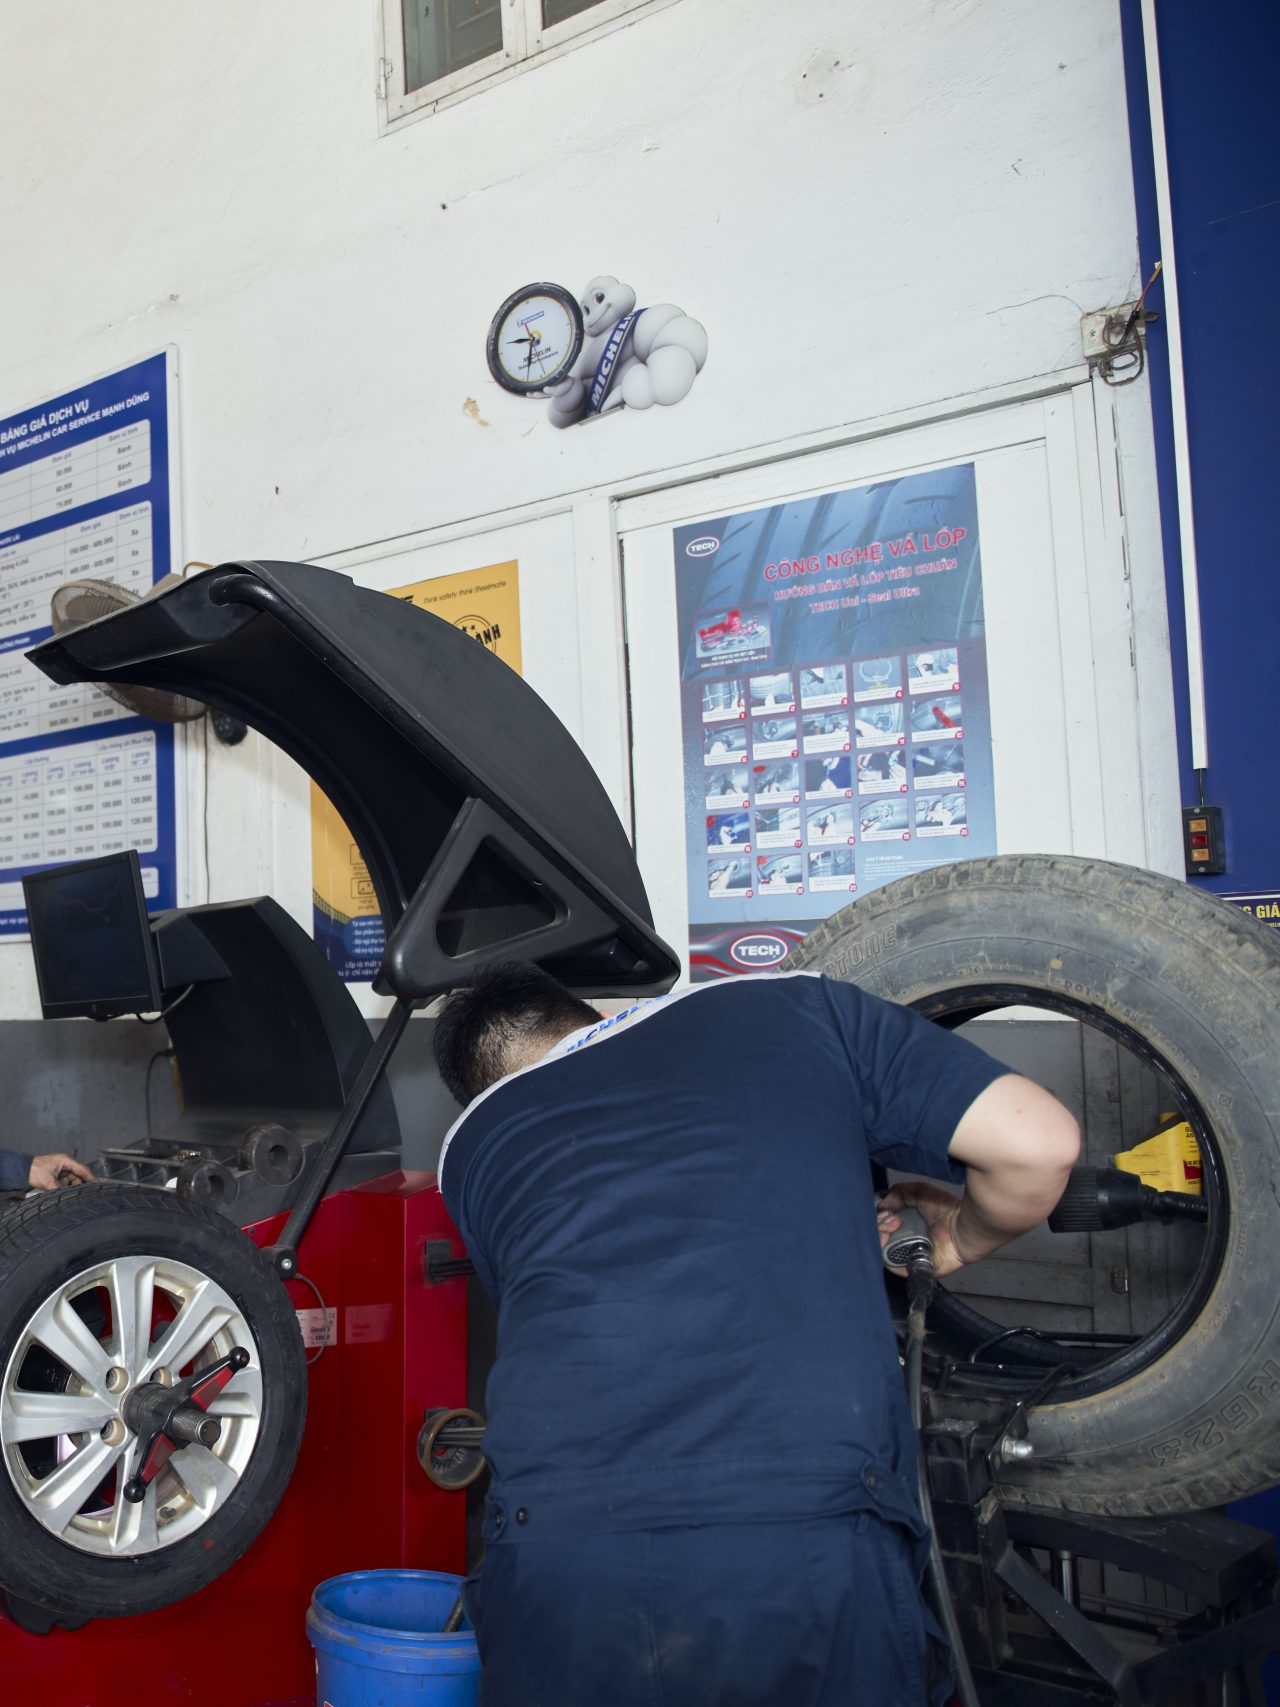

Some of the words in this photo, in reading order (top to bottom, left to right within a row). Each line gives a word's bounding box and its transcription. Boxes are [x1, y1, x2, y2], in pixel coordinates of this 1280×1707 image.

[523, 346, 551, 362] MCHELIN
[0, 423, 28, 444] BẢNG
[29, 413, 47, 431] GIÁ
[49, 403, 73, 424] DỊCH
[74, 399, 90, 413] VỤ
[17, 430, 51, 450] MICHELIN
[51, 423, 68, 437] CAR
[68, 411, 101, 431] SERVICE
[690, 541, 715, 553] TECH
[764, 556, 820, 582] CÔNG
[826, 541, 883, 570] NGHỆ
[887, 532, 918, 558] VÁ
[923, 526, 966, 552] LỐP
[861, 569, 884, 586] LỐP
[886, 565, 912, 582] TIÊU
[915, 557, 957, 576] CHUẨN
[809, 598, 839, 614] TECH
[868, 590, 892, 604] Seal
[1256, 902, 1280, 918] GIÁ
[738, 945, 780, 956] TECH
